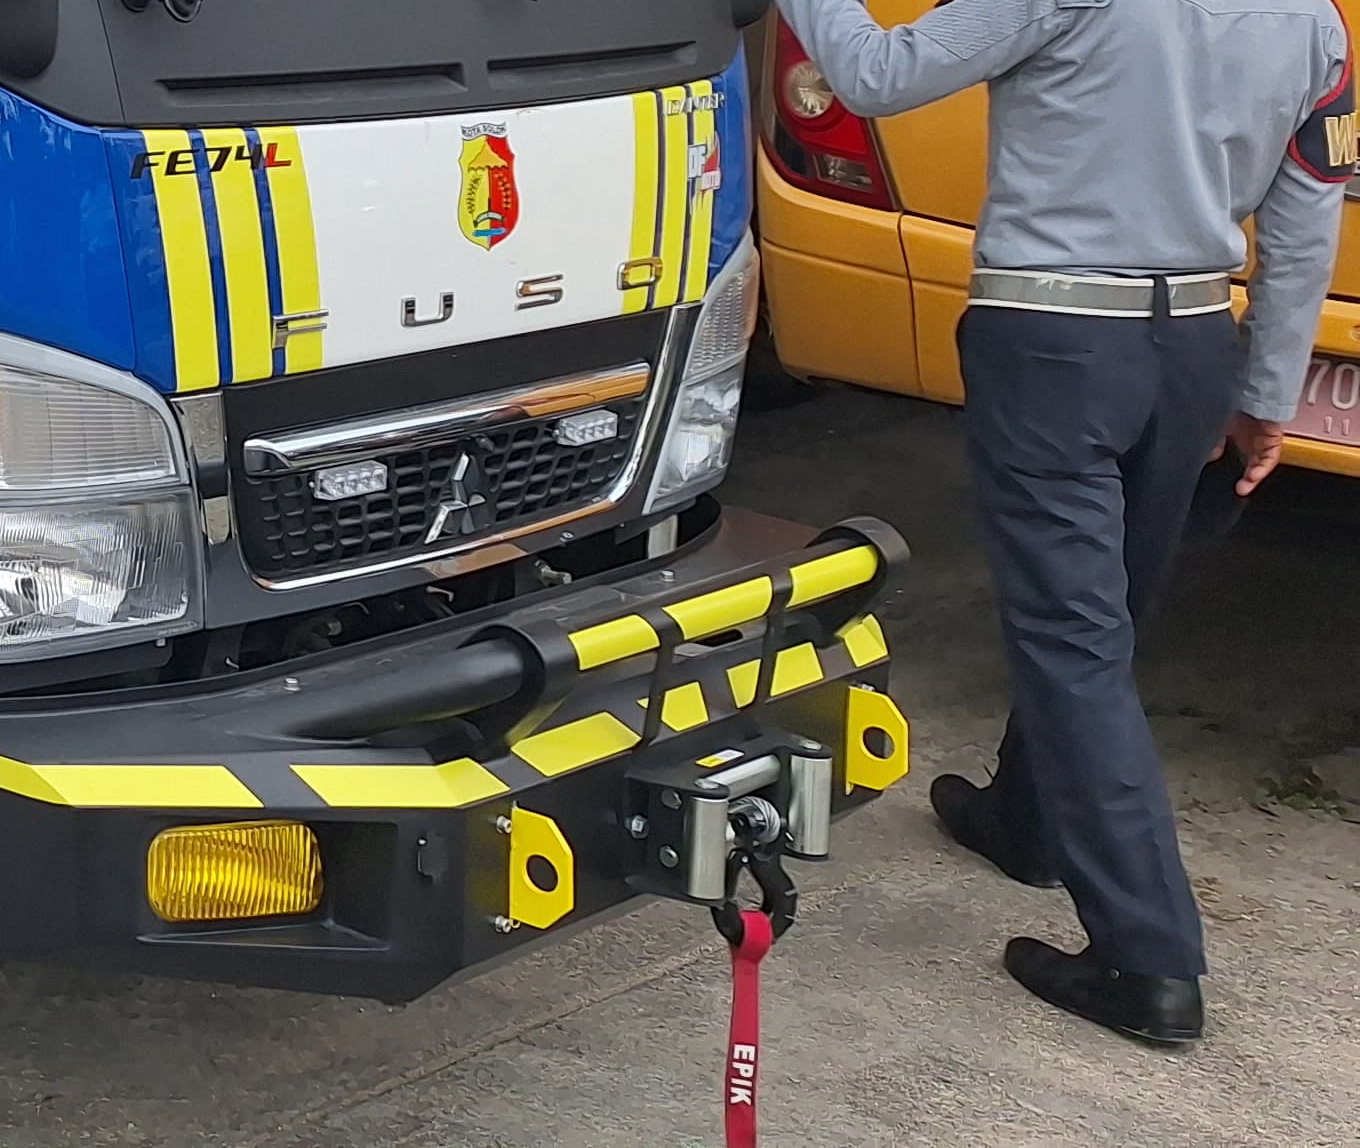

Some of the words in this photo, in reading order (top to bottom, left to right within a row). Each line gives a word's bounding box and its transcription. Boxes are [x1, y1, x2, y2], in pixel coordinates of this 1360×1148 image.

[130, 142, 292, 179] FE74L
[272, 256, 664, 350] FUSO
[730, 1043, 756, 1106] EPIK
